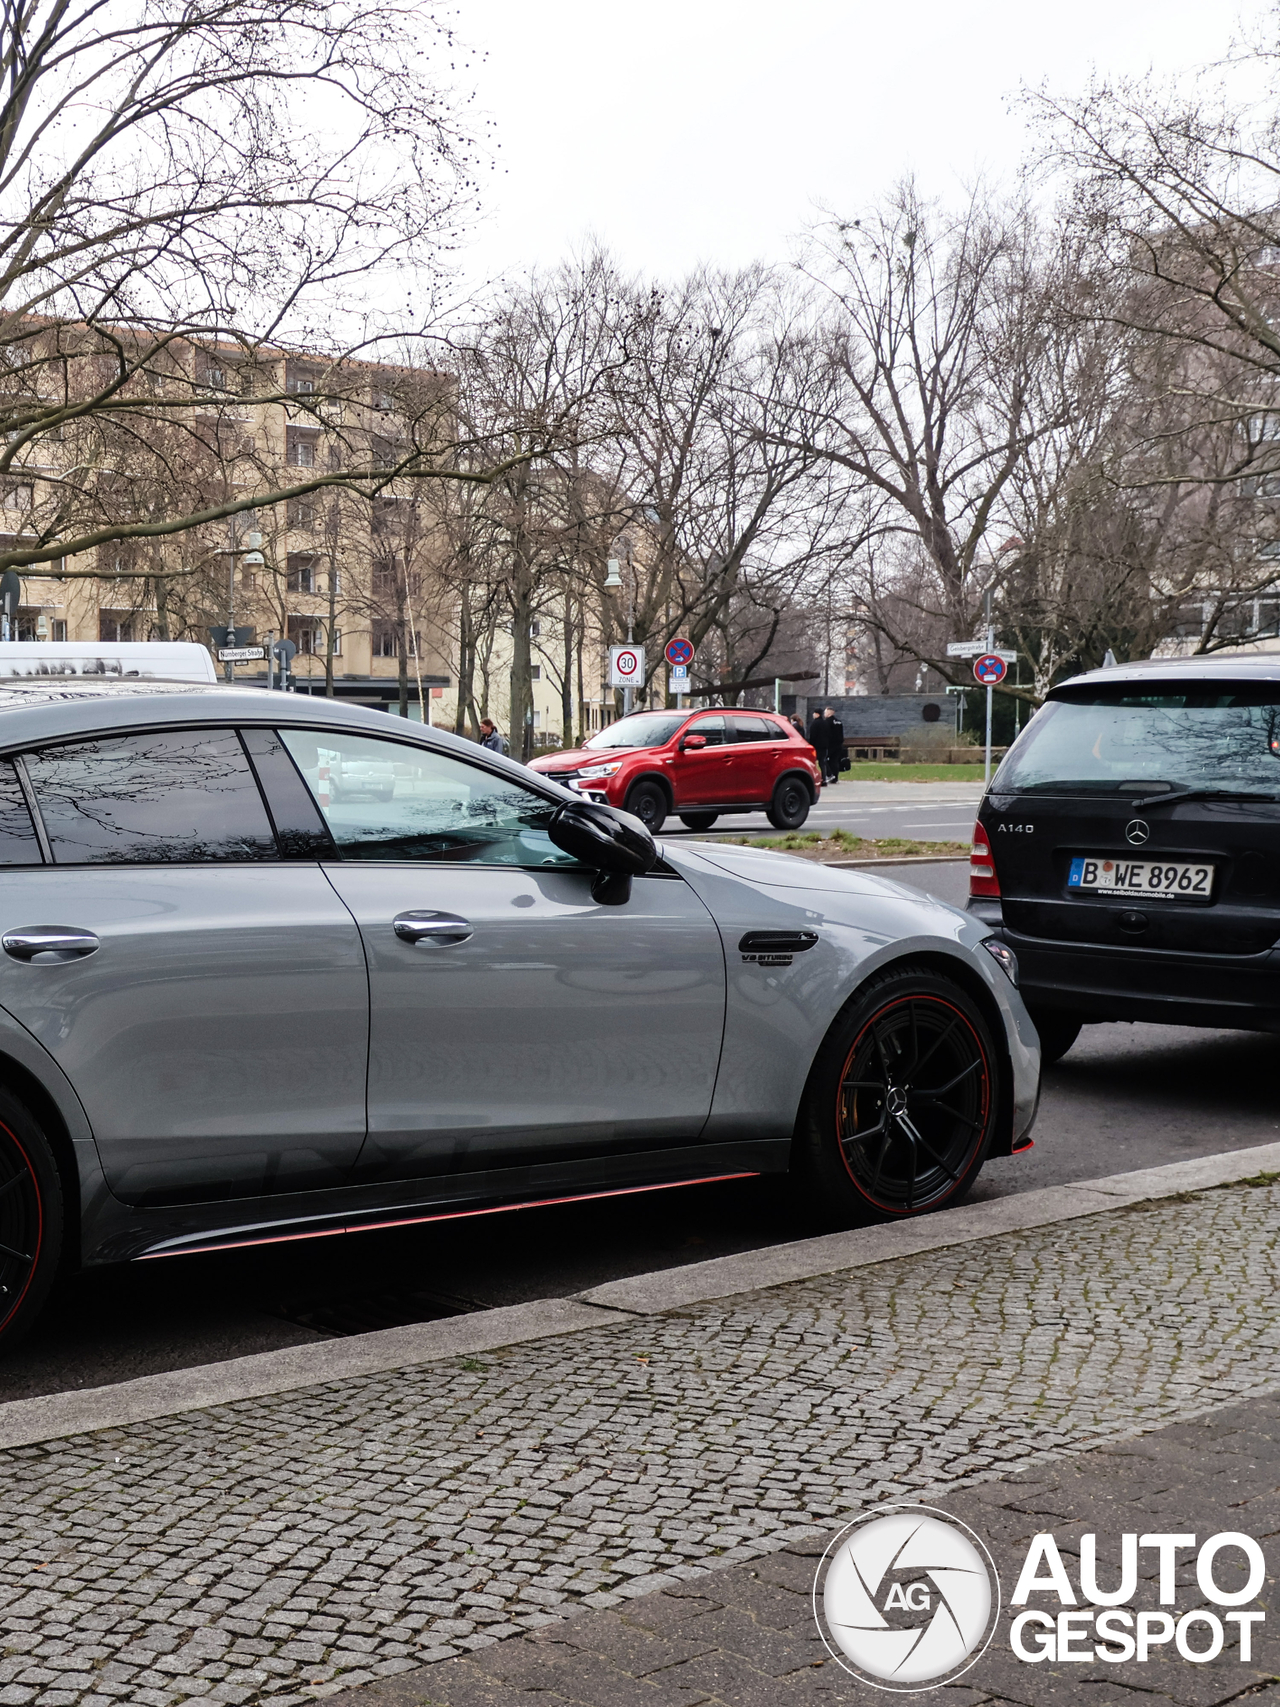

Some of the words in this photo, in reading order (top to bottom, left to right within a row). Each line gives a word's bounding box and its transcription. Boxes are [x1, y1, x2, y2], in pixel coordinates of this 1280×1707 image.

[220, 650, 247, 658] Nürnberger
[247, 648, 263, 657] Straße
[620, 657, 633, 669] 30
[1083, 862, 1098, 885] B
[1115, 864, 1144, 888] WE
[1148, 866, 1208, 892] 8962
[1097, 888, 1175, 899] www.seiboldautomobile.de
